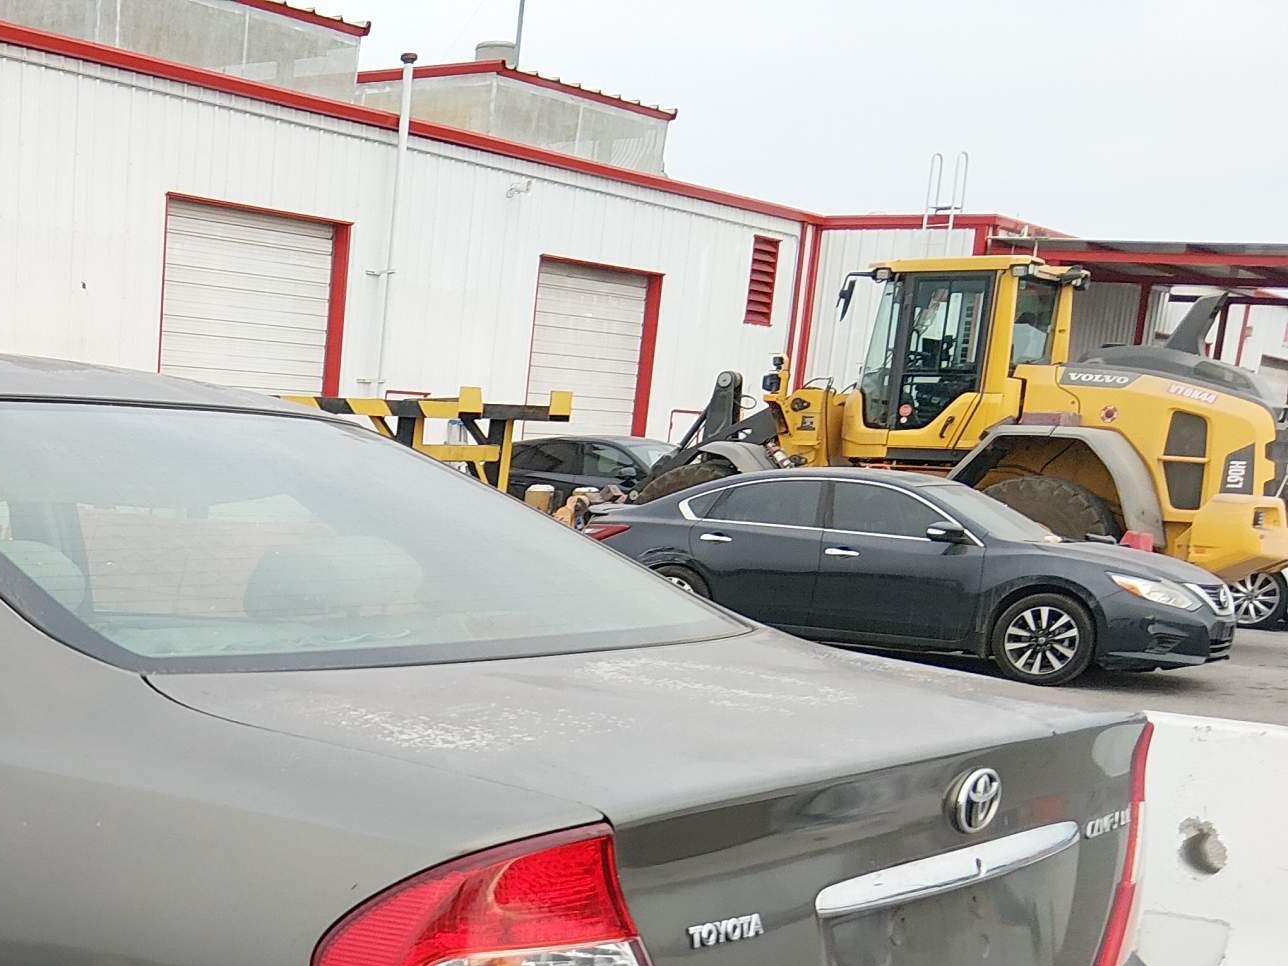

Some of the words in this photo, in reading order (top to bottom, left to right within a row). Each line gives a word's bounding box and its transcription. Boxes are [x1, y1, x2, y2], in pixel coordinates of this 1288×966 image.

[1068, 372, 1129, 384] VOLVO
[1225, 460, 1248, 489] L90H
[688, 913, 764, 949] TOYOTA
